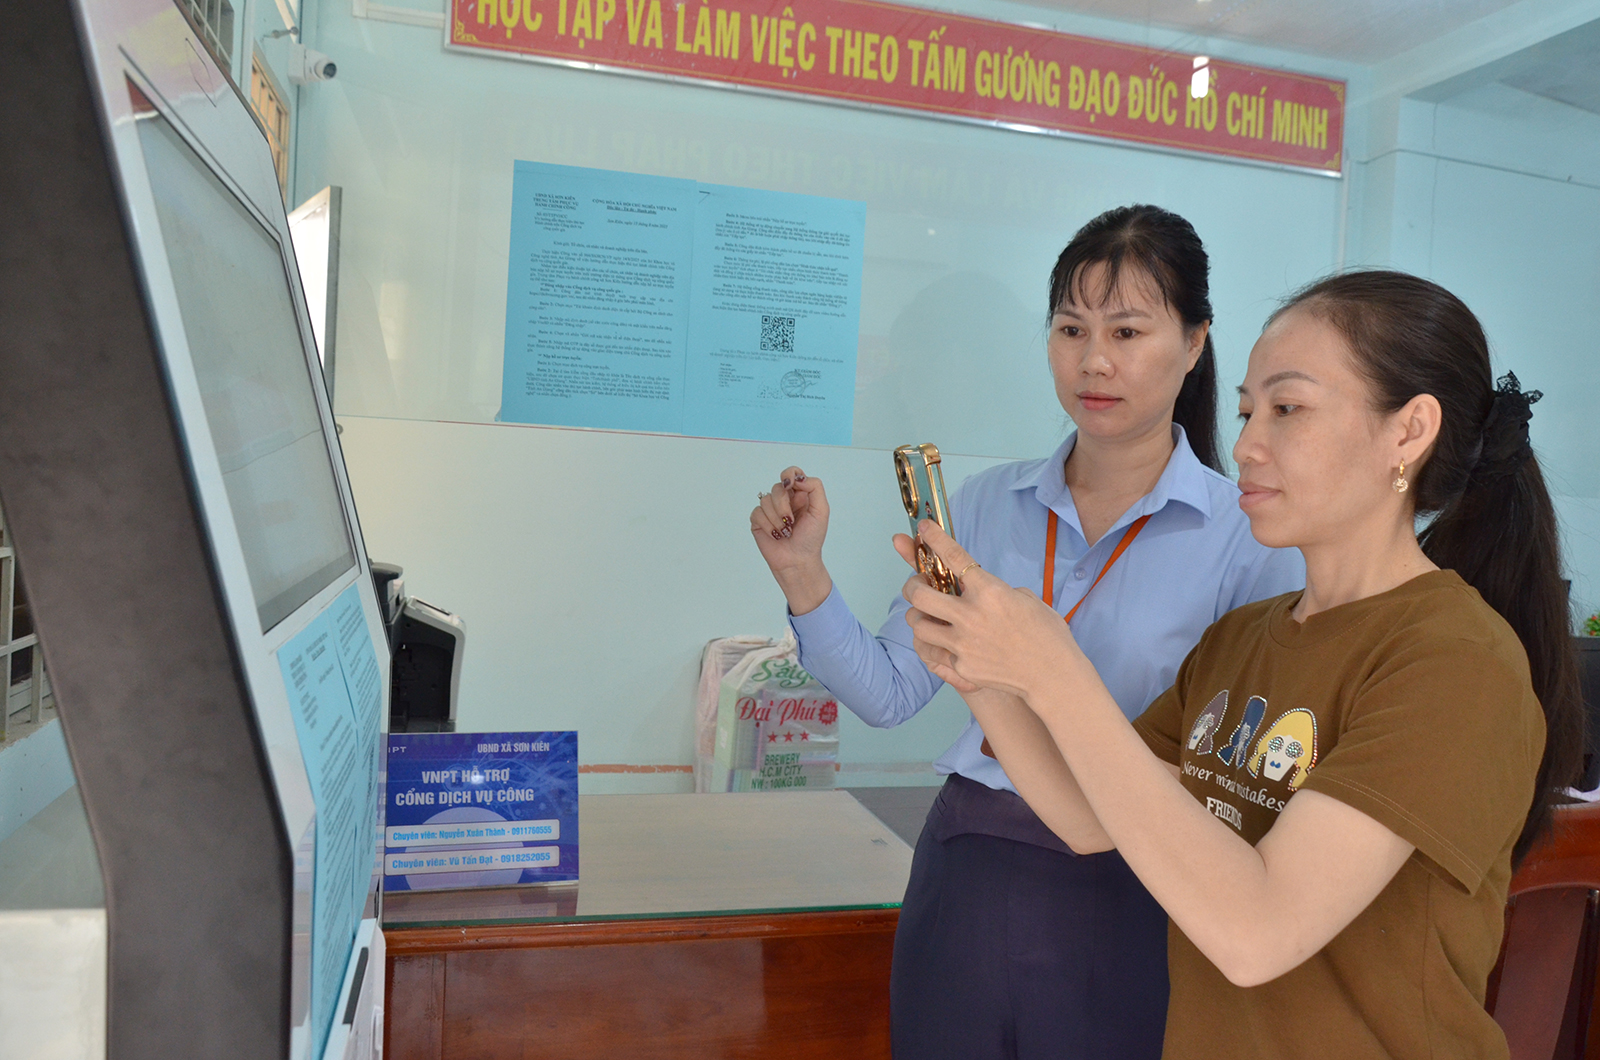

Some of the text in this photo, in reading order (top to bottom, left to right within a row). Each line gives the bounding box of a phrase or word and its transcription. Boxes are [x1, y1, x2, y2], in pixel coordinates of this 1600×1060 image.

[477, 0, 543, 39] HỌC
[751, 6, 816, 78] VIỆC
[825, 26, 899, 84] THEO
[907, 26, 967, 93] TẤM
[974, 46, 1061, 108] GƯƠNG
[1068, 65, 1120, 123] ĐẠO
[1128, 66, 1178, 126] ĐỨC
[1185, 69, 1218, 132] HỒ
[1226, 86, 1267, 139] CHÍ
[1271, 99, 1328, 150] MINH
[735, 696, 774, 728] Đại
[777, 698, 817, 726] Phú
[477, 740, 550, 753] UBND XÃ SƠN KIÊN
[764, 753, 801, 765] BREWERY
[422, 766, 510, 784] VNPT HỖ TRỢ
[784, 765, 803, 776] CITY
[1181, 761, 1213, 781] Never
[395, 787, 534, 806] CỔNG DỊCH VỤ CÔNG
[392, 831, 419, 841] Chuyên
[420, 830, 437, 840] viên:
[439, 828, 465, 840] Nguyễn
[466, 828, 484, 838] Xuân
[485, 827, 506, 836] Thành
[392, 858, 424, 869] Chuyên
[426, 857, 447, 867] viên:
[449, 856, 460, 865] Vũ
[462, 854, 477, 865] Tấn
[479, 855, 493, 866] Đạt
[500, 852, 551, 863] 0918252055
